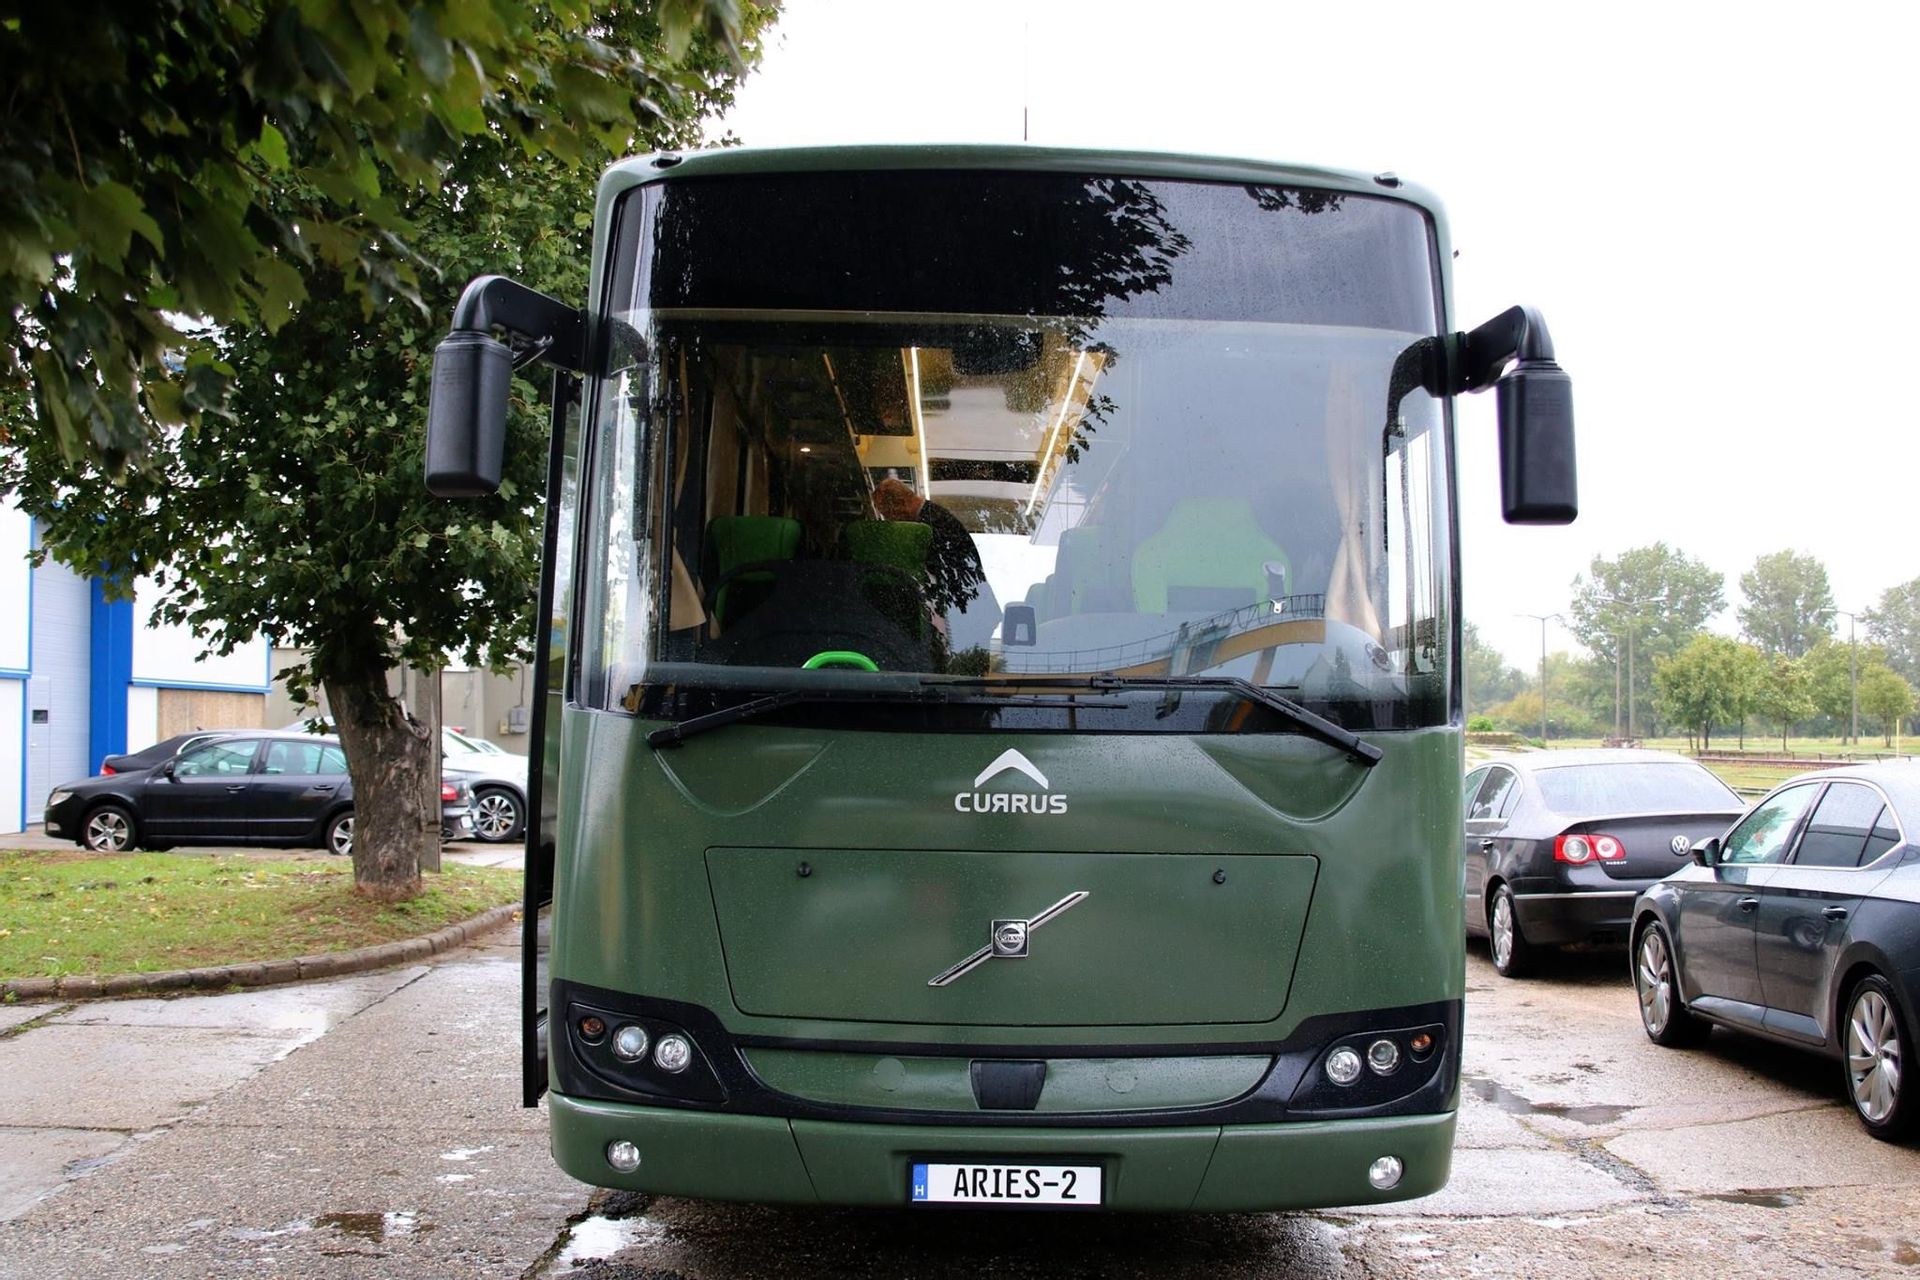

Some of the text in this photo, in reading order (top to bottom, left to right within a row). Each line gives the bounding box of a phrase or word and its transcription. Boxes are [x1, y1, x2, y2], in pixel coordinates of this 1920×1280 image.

[954, 792, 1068, 814] CURRUS
[914, 1184, 925, 1197] H
[953, 1168, 1077, 1199] ARIES-2
